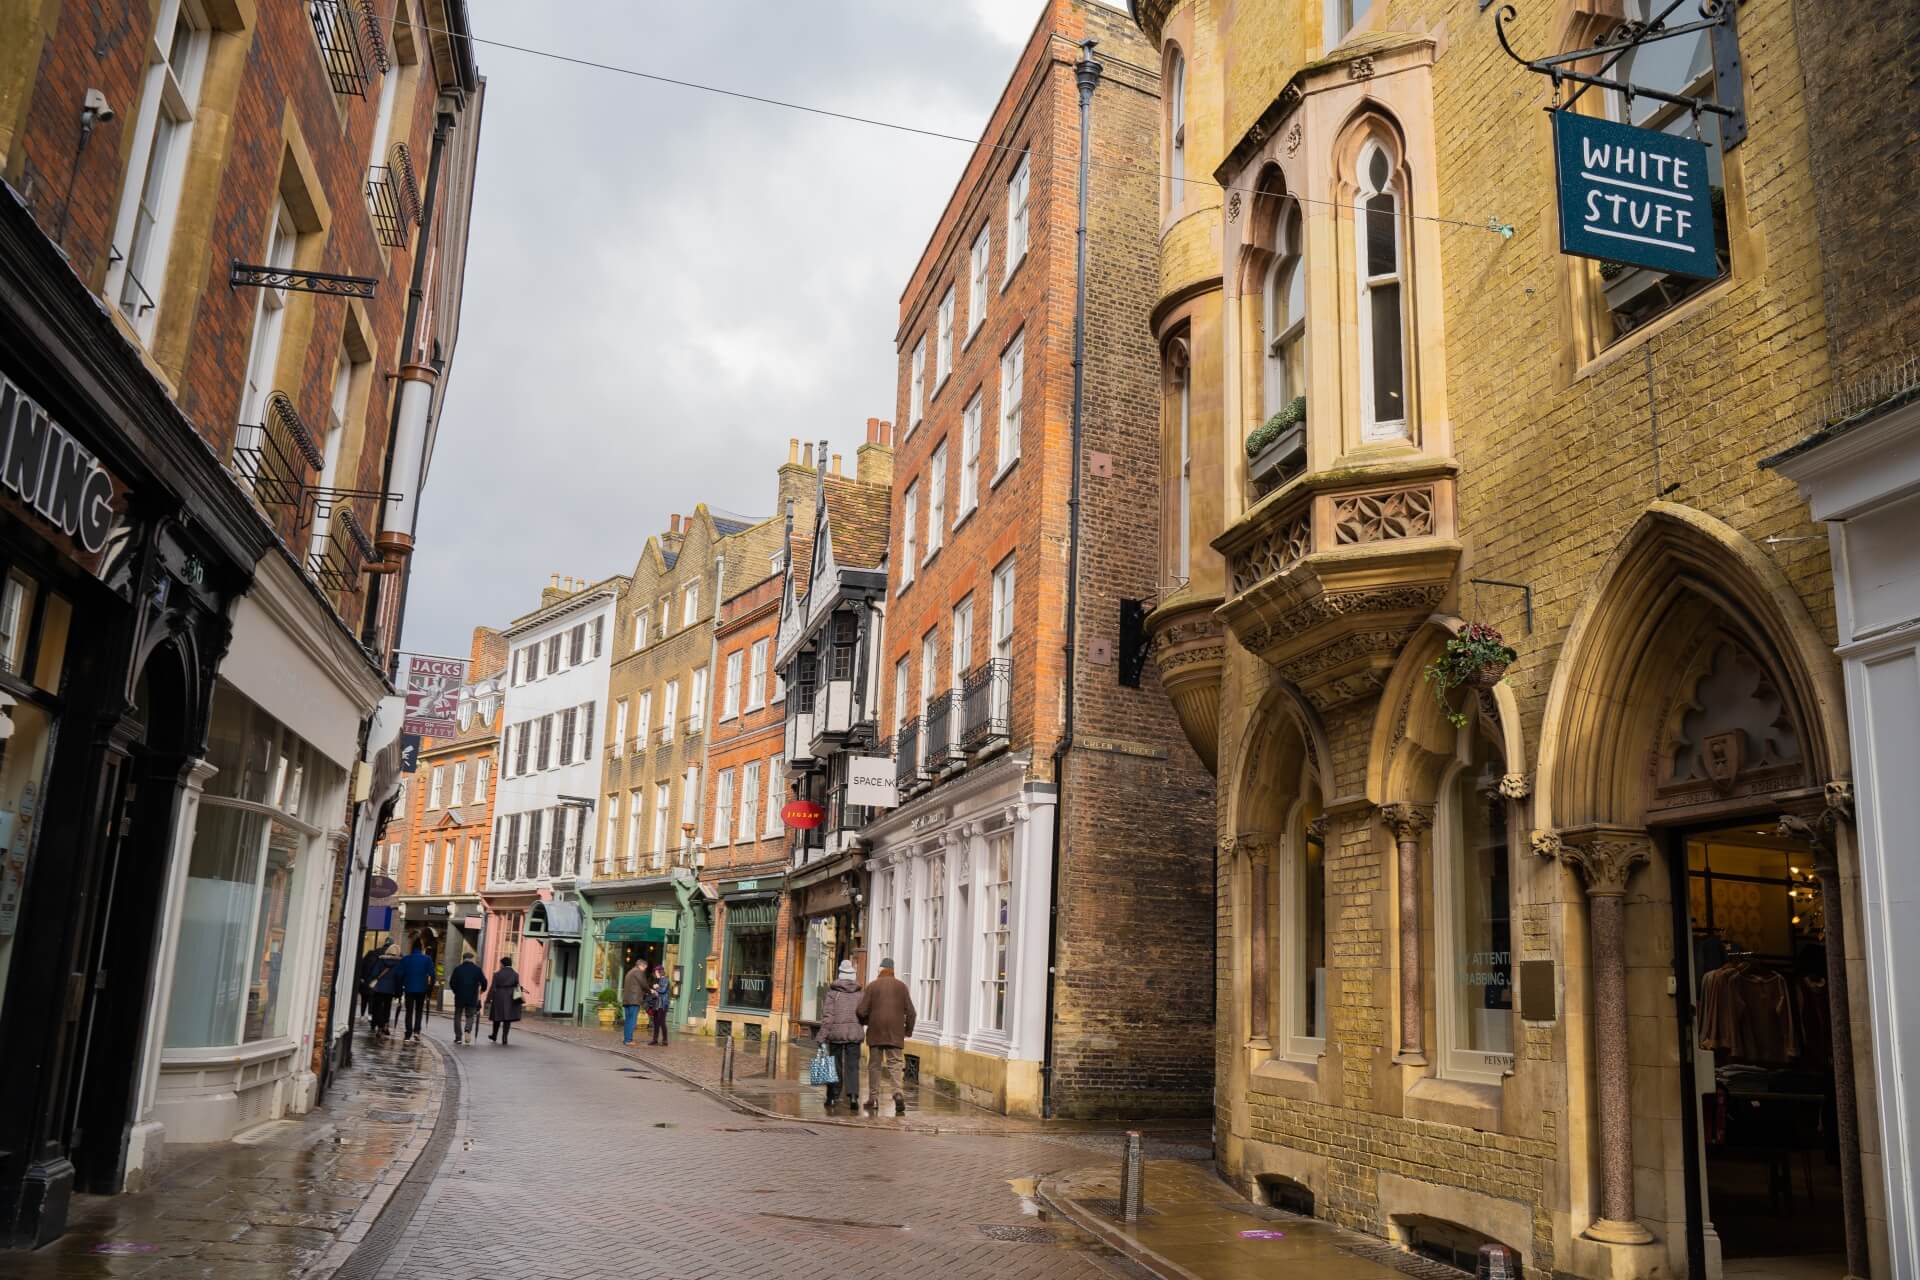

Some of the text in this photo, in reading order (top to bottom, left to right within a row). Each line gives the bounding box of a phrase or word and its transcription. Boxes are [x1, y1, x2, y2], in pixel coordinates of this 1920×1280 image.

[1583, 136, 1689, 189] WHITE
[1584, 189, 1692, 238] STUFF
[412, 660, 462, 676] JACKS
[405, 725, 453, 737] TRINITY
[1083, 738, 1158, 757] GREEN STREET
[787, 811, 819, 819] JIGSAW
[741, 978, 767, 992] TRINITY
